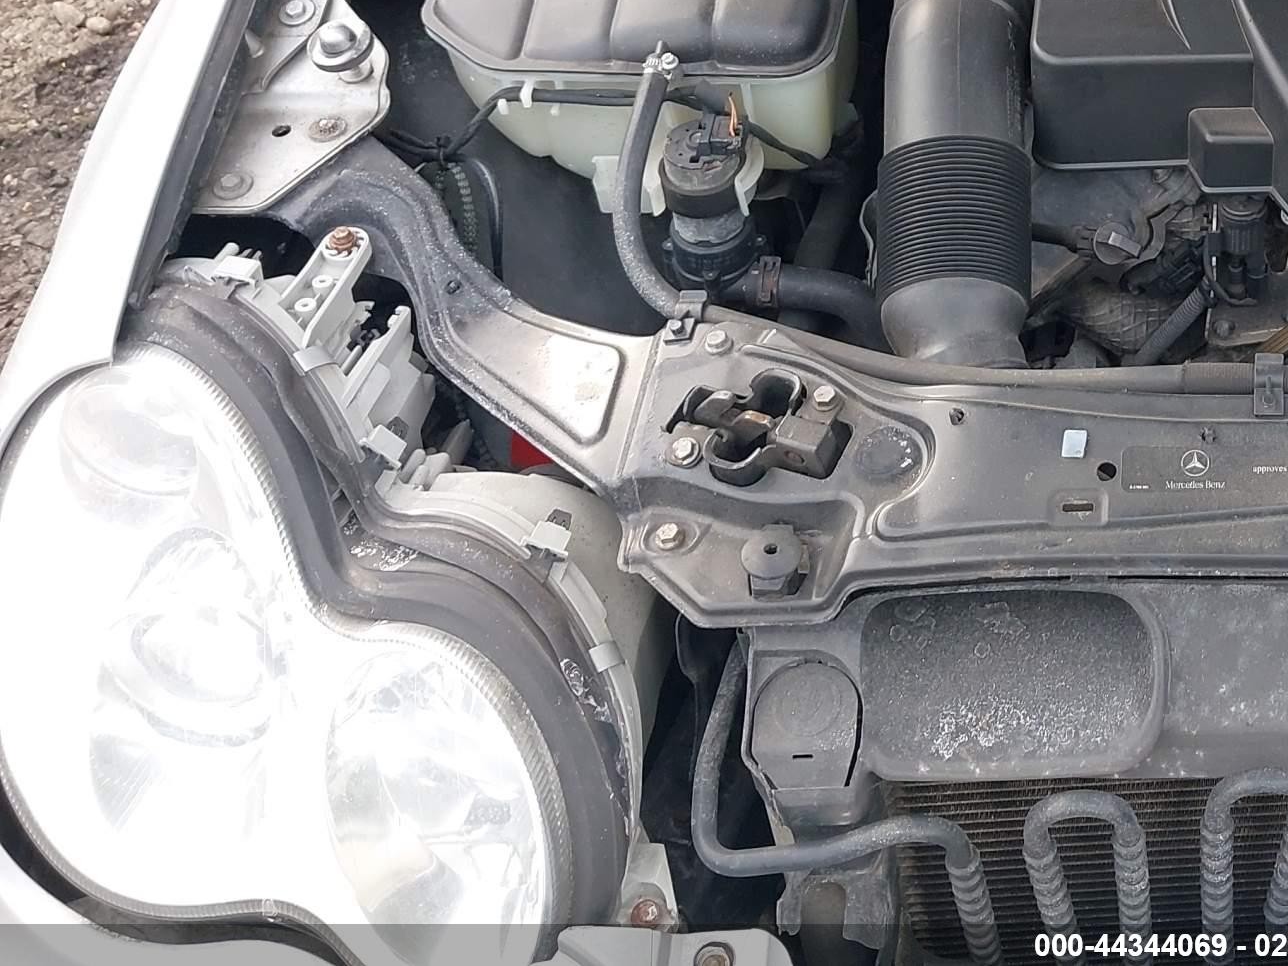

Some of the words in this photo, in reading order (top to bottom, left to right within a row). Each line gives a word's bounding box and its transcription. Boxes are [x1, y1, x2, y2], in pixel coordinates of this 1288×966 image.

[1252, 464, 1288, 473] approves
[1165, 480, 1203, 489] Mercedes
[1205, 480, 1226, 490] Benz
